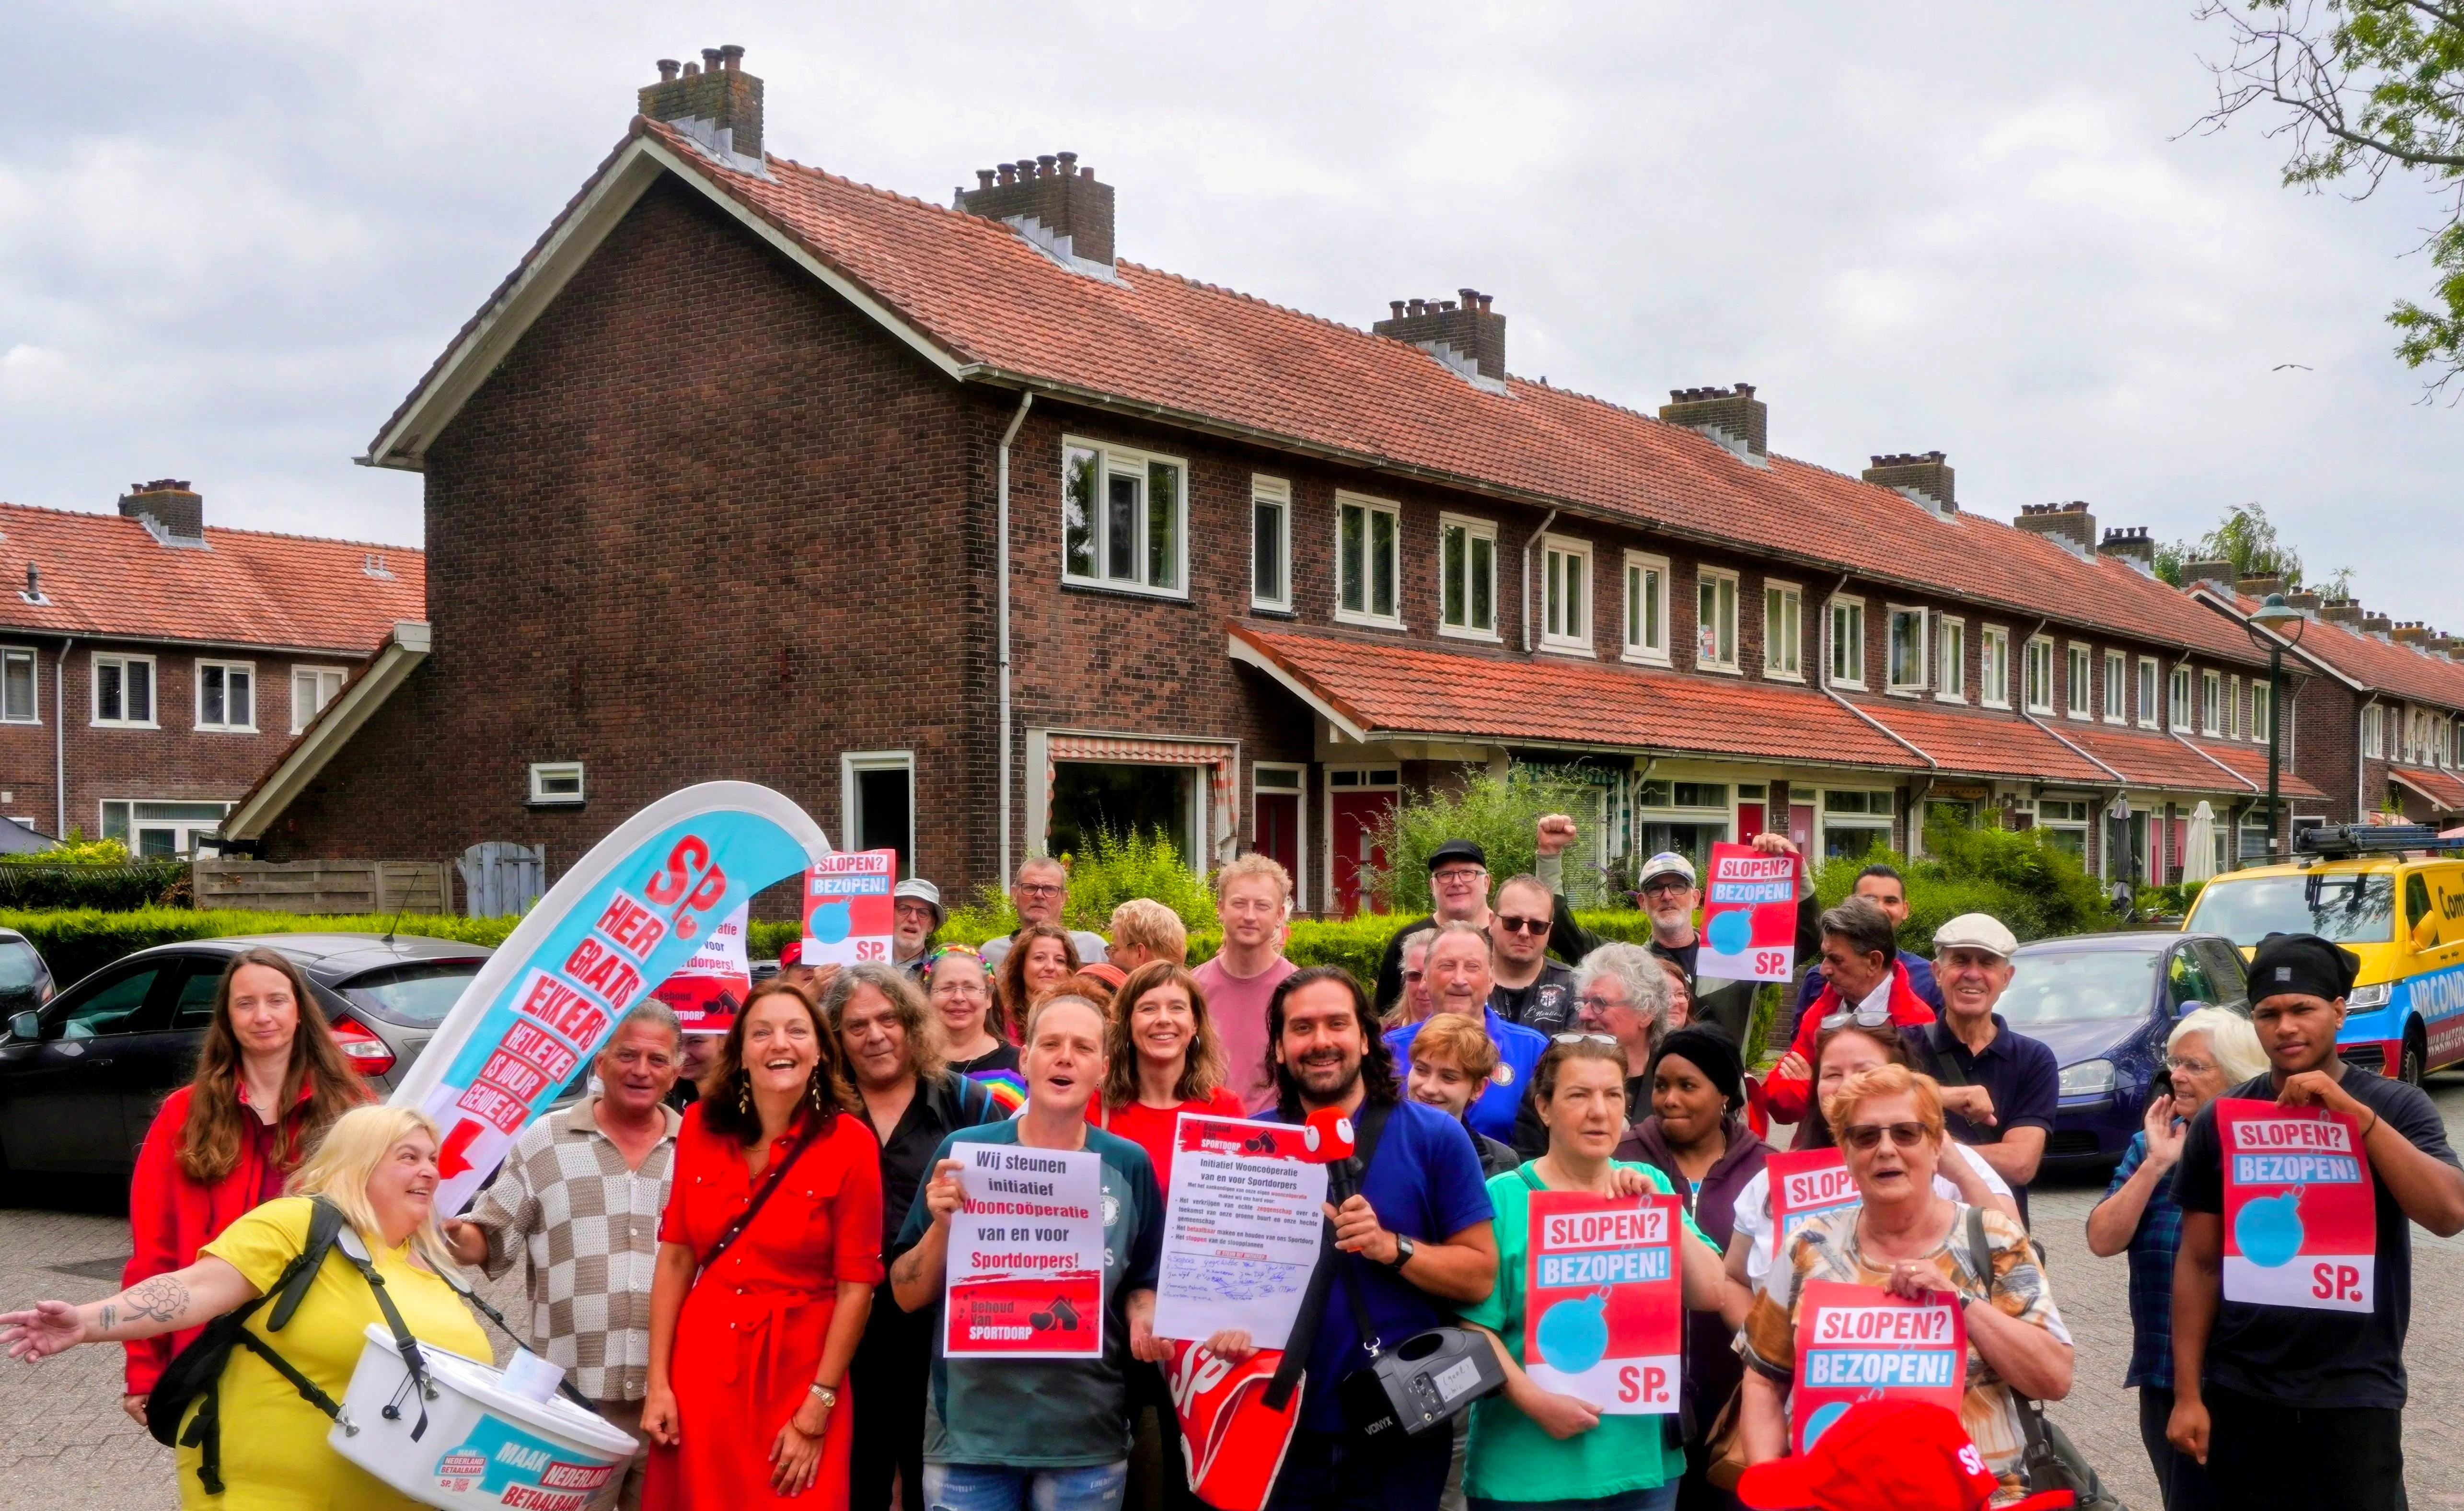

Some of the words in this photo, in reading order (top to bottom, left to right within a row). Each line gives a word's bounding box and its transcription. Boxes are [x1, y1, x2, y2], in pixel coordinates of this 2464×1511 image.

[819, 857, 883, 872] SLOPEN?
[1723, 860, 1789, 877] SLOPEN?
[814, 877, 885, 894] BEZOPEN!
[1715, 882, 1790, 900] BEZOPEN!
[705, 941, 724, 952] voor
[856, 941, 886, 961] SP.
[681, 956, 734, 971] tdorpers!
[1755, 952, 1786, 975] SP.
[565, 938, 639, 1009] GRATIS
[484, 1054, 506, 1078] IS
[2240, 1124, 2342, 1147] SLOPEN?
[1201, 1139, 1241, 1151] SPORTDORP
[976, 1151, 1001, 1170] Wij
[1006, 1155, 1066, 1174] steunen
[1200, 1159, 1233, 1170] Initiatief
[1236, 1162, 1298, 1176] Wooncoöperatie
[2240, 1157, 2357, 1181] BEZOPEN!
[988, 1178, 1053, 1196] initiatief
[1248, 1177, 1297, 1190] Sportdorpers
[962, 1198, 1088, 1219] Wooncoöperatie
[1257, 1206, 1292, 1215] zeggenschap
[1178, 1216, 1215, 1225] gemeenschap
[1551, 1213, 1661, 1244] SLOPEN?
[978, 1228, 1005, 1241] van
[1011, 1228, 1029, 1241] en
[1035, 1228, 1069, 1241] voor
[1187, 1226, 1215, 1234] betaalbaar
[1288, 1236, 1314, 1245] Sportdorp
[1227, 1240, 1263, 1248] sloopplannen
[972, 1252, 1078, 1270] Sportdorpers!
[1544, 1254, 1666, 1285] BEZOPEN!
[2313, 1262, 2363, 1302] SP.
[181, 1287, 190, 1304] LOVE
[178, 1305, 188, 1316] ME
[971, 1301, 1014, 1313] Behoud
[971, 1313, 991, 1325] Van
[1822, 1311, 1946, 1339] SLOPEN?
[969, 1326, 1032, 1340] SPORTDORP
[1812, 1354, 1949, 1383] BEZOPEN!
[1618, 1366, 1670, 1403] SP.
[1365, 1416, 1393, 1435] VONYX
[495, 1442, 552, 1472] MAAK
[544, 1465, 612, 1487] NEDERLAND
